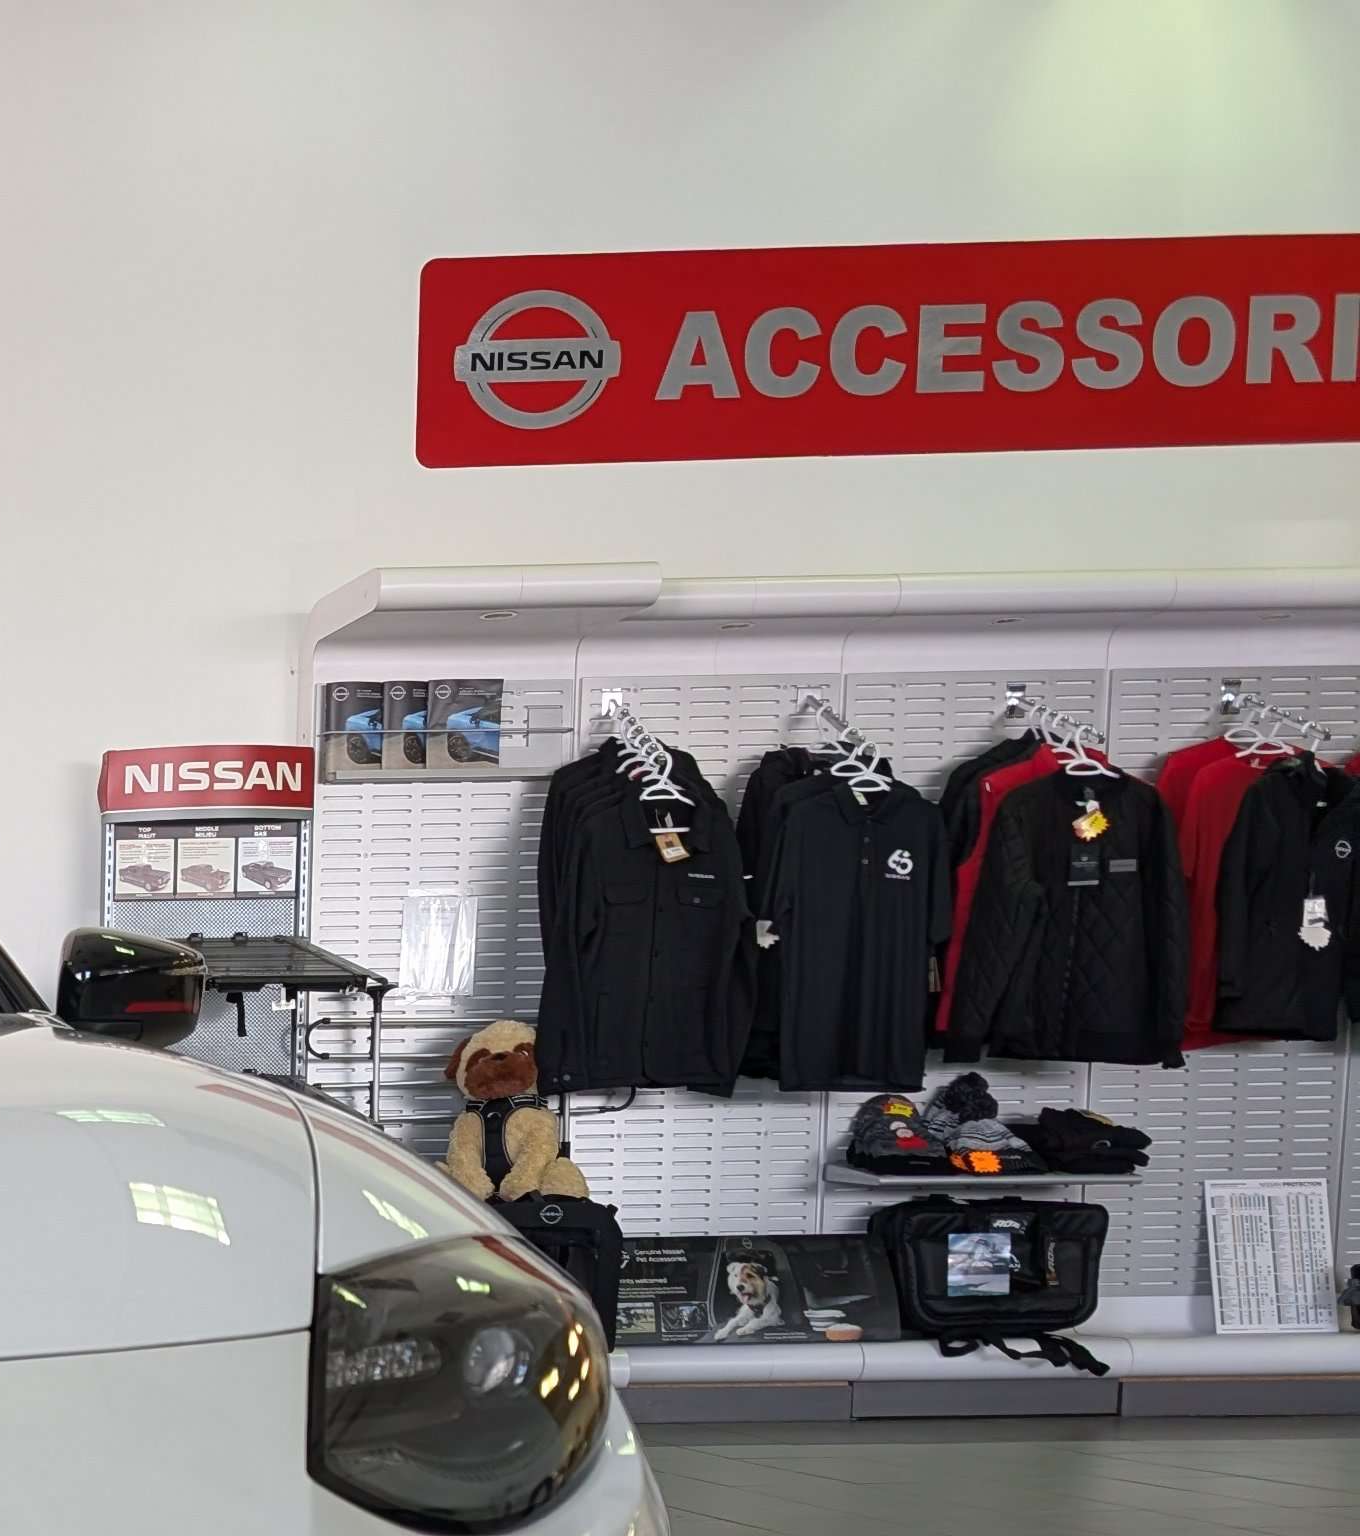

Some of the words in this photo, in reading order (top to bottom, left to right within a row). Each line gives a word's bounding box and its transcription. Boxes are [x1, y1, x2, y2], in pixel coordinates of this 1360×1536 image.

[470, 348, 605, 373] NISSAN
[655, 294, 1360, 401] ACCESSORI
[123, 760, 303, 795] NISSAN
